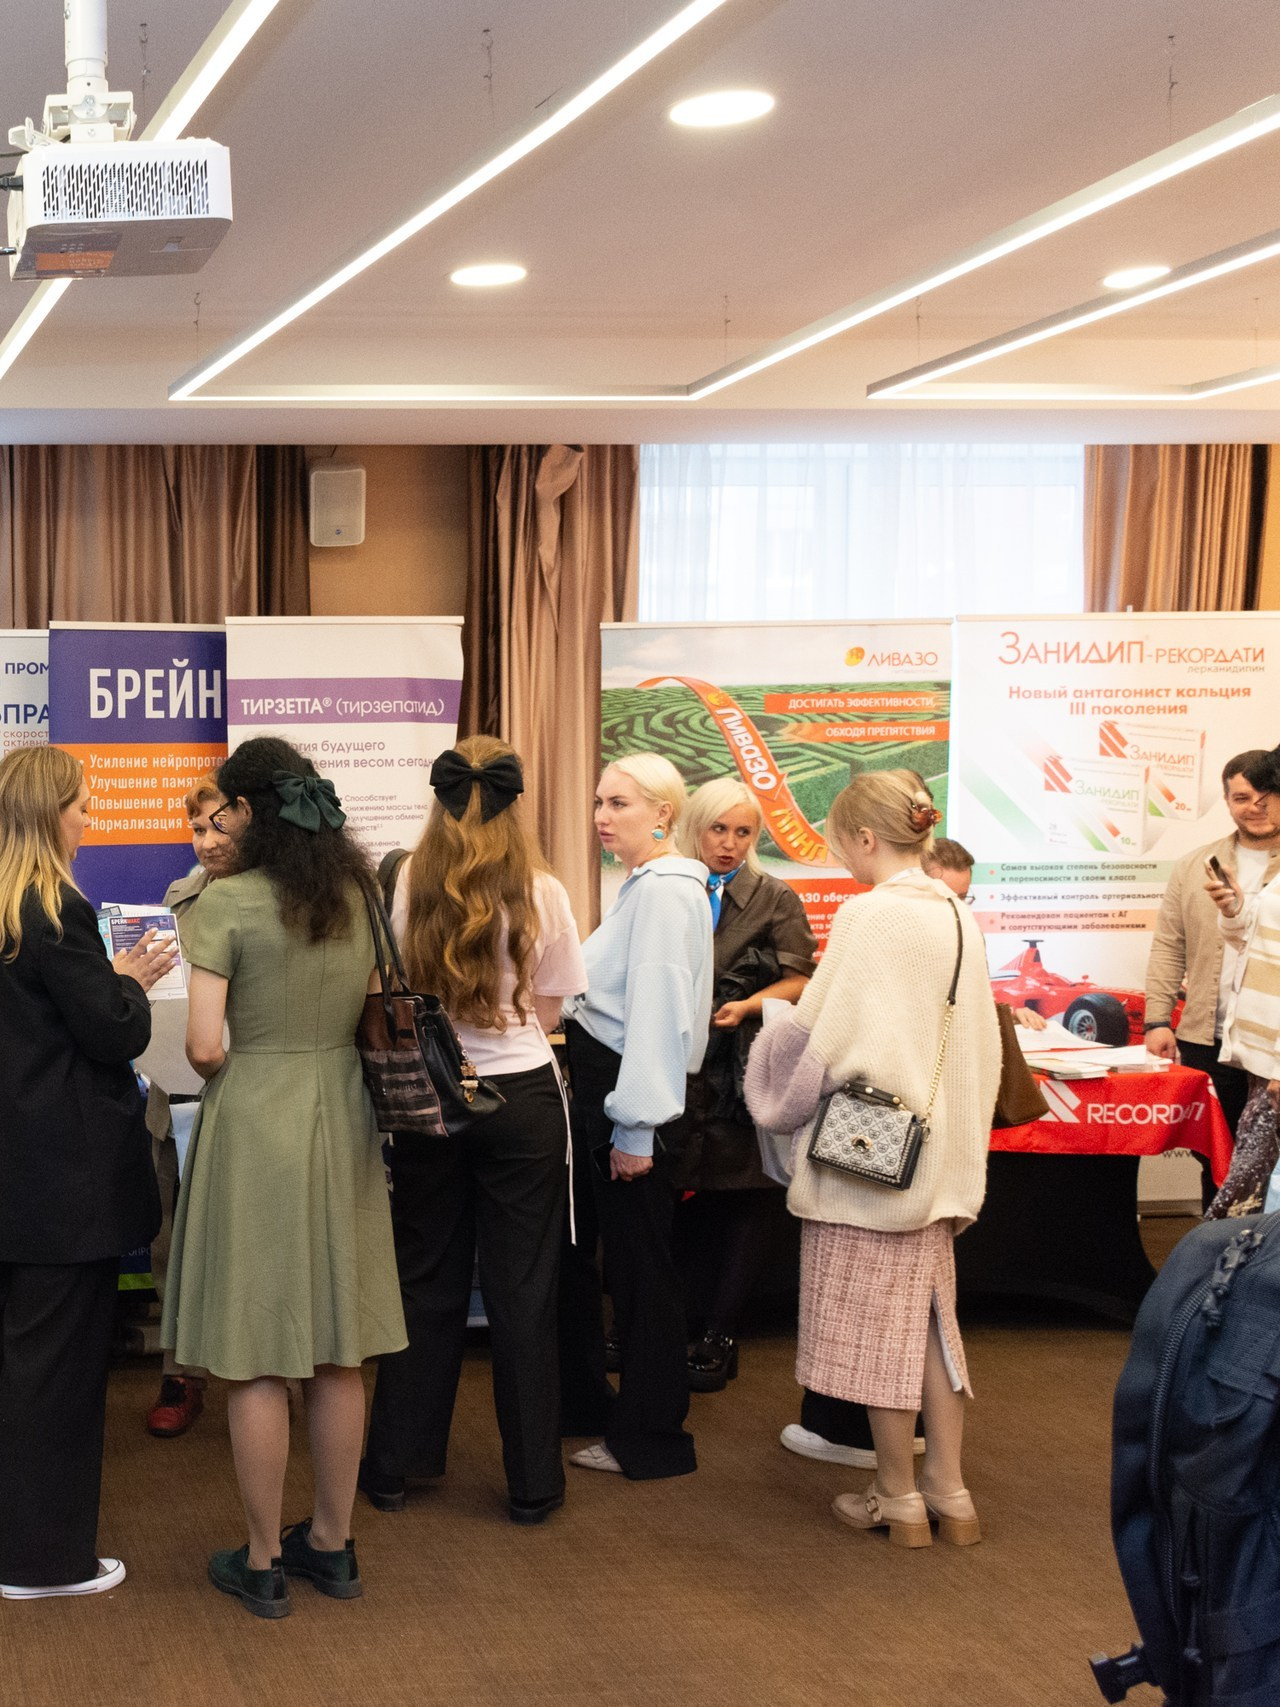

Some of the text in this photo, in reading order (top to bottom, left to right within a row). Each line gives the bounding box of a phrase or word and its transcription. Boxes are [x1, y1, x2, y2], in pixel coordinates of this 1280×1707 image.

[867, 651, 938, 667] ЛИВАЗО
[1187, 665, 1266, 674] лерканидипин
[89, 658, 222, 719] БРЕЙН
[1009, 685, 1252, 700] Новый антагонист кальция
[336, 698, 444, 716] (тирзепатид)
[788, 697, 936, 710] ДОСТИГАТЬ ЭФФЕКТИВНОСТИ,
[1070, 702, 1188, 716] III поколения
[825, 726, 936, 737] ОБХОДЯ ПРЕПЯТСТВИЯ
[321, 740, 386, 755] будущего
[90, 754, 148, 769] Усиление
[353, 758, 394, 768] весом
[90, 775, 158, 792] Улучшение
[90, 796, 163, 810] Повышение
[344, 794, 397, 802] Способствует
[345, 804, 385, 813] снижению
[386, 803, 413, 812] массы
[1174, 803, 1186, 811] 20
[91, 816, 183, 833] Нормализация
[351, 814, 393, 824] улучшению
[1120, 837, 1131, 845] 10
[1000, 862, 1158, 871] Самая высокая степень безопасности
[1000, 893, 1059, 901] Эффективный
[1000, 912, 1061, 920] Рекомендован
[1063, 911, 1110, 919] пациентам
[1008, 924, 1078, 932] сопутствующими
[1080, 922, 1147, 930] заболеваниями
